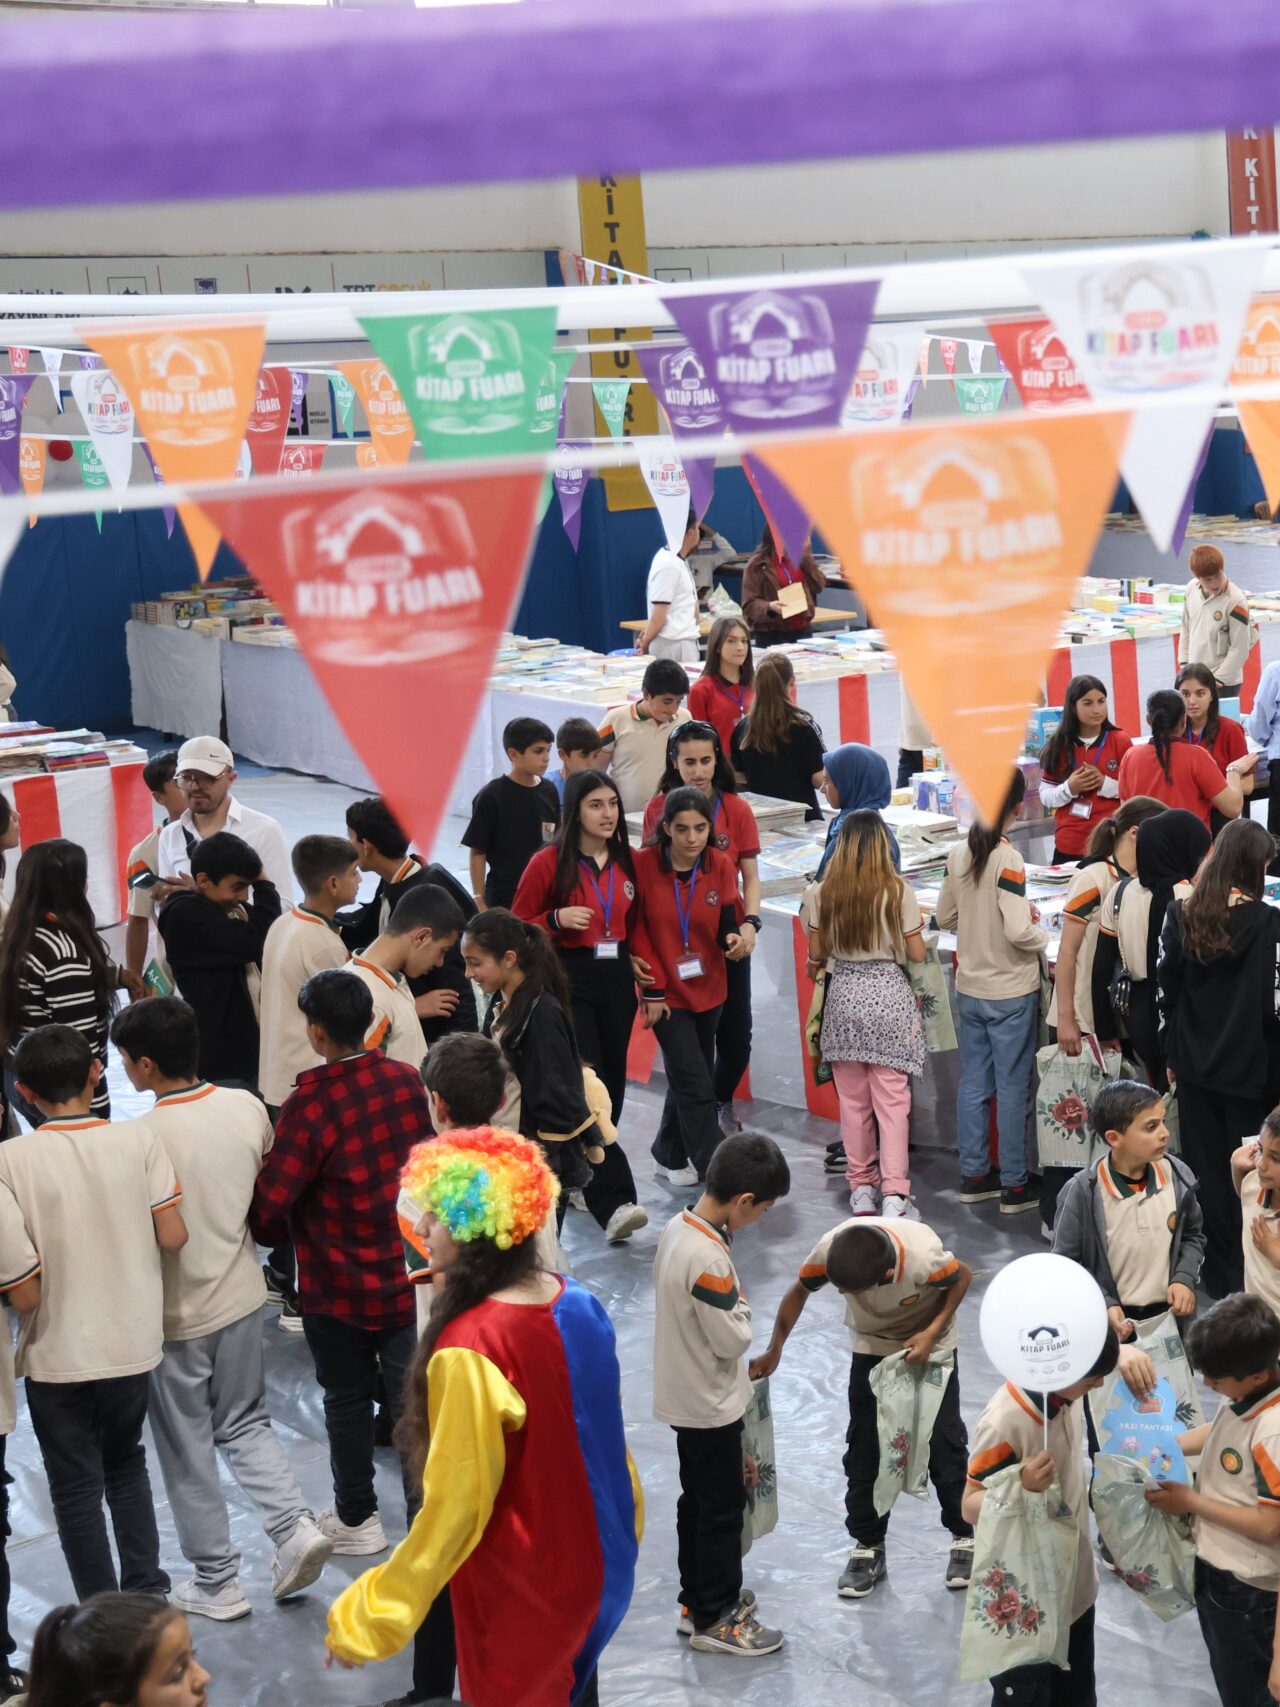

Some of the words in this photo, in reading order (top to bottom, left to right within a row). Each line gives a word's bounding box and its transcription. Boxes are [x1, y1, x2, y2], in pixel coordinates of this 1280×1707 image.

[1151, 322, 1219, 354] FUARI
[718, 353, 770, 384] KİTAP
[774, 349, 836, 382] FUARI
[416, 371, 465, 401] KİTAP
[469, 370, 525, 400] FUARI
[1021, 368, 1053, 387] KİTAP
[140, 388, 183, 413] KİTAP
[188, 387, 237, 413] FUARI
[256, 397, 281, 413] FUARI
[536, 394, 556, 412] FUARI
[665, 388, 692, 406] KİTAP
[88, 402, 110, 416] KİTAP
[651, 469, 670, 482] KİTAP
[863, 526, 949, 566] KİTAP
[958, 514, 1062, 563] FUARI
[296, 576, 377, 618] KİTAP
[384, 566, 483, 614] FUARI
[1020, 1344, 1044, 1352] KİTAP
[1047, 1339, 1070, 1352] FUARI
[1120, 1423, 1137, 1431] YAZI
[1140, 1423, 1173, 1432] TAHTASI
